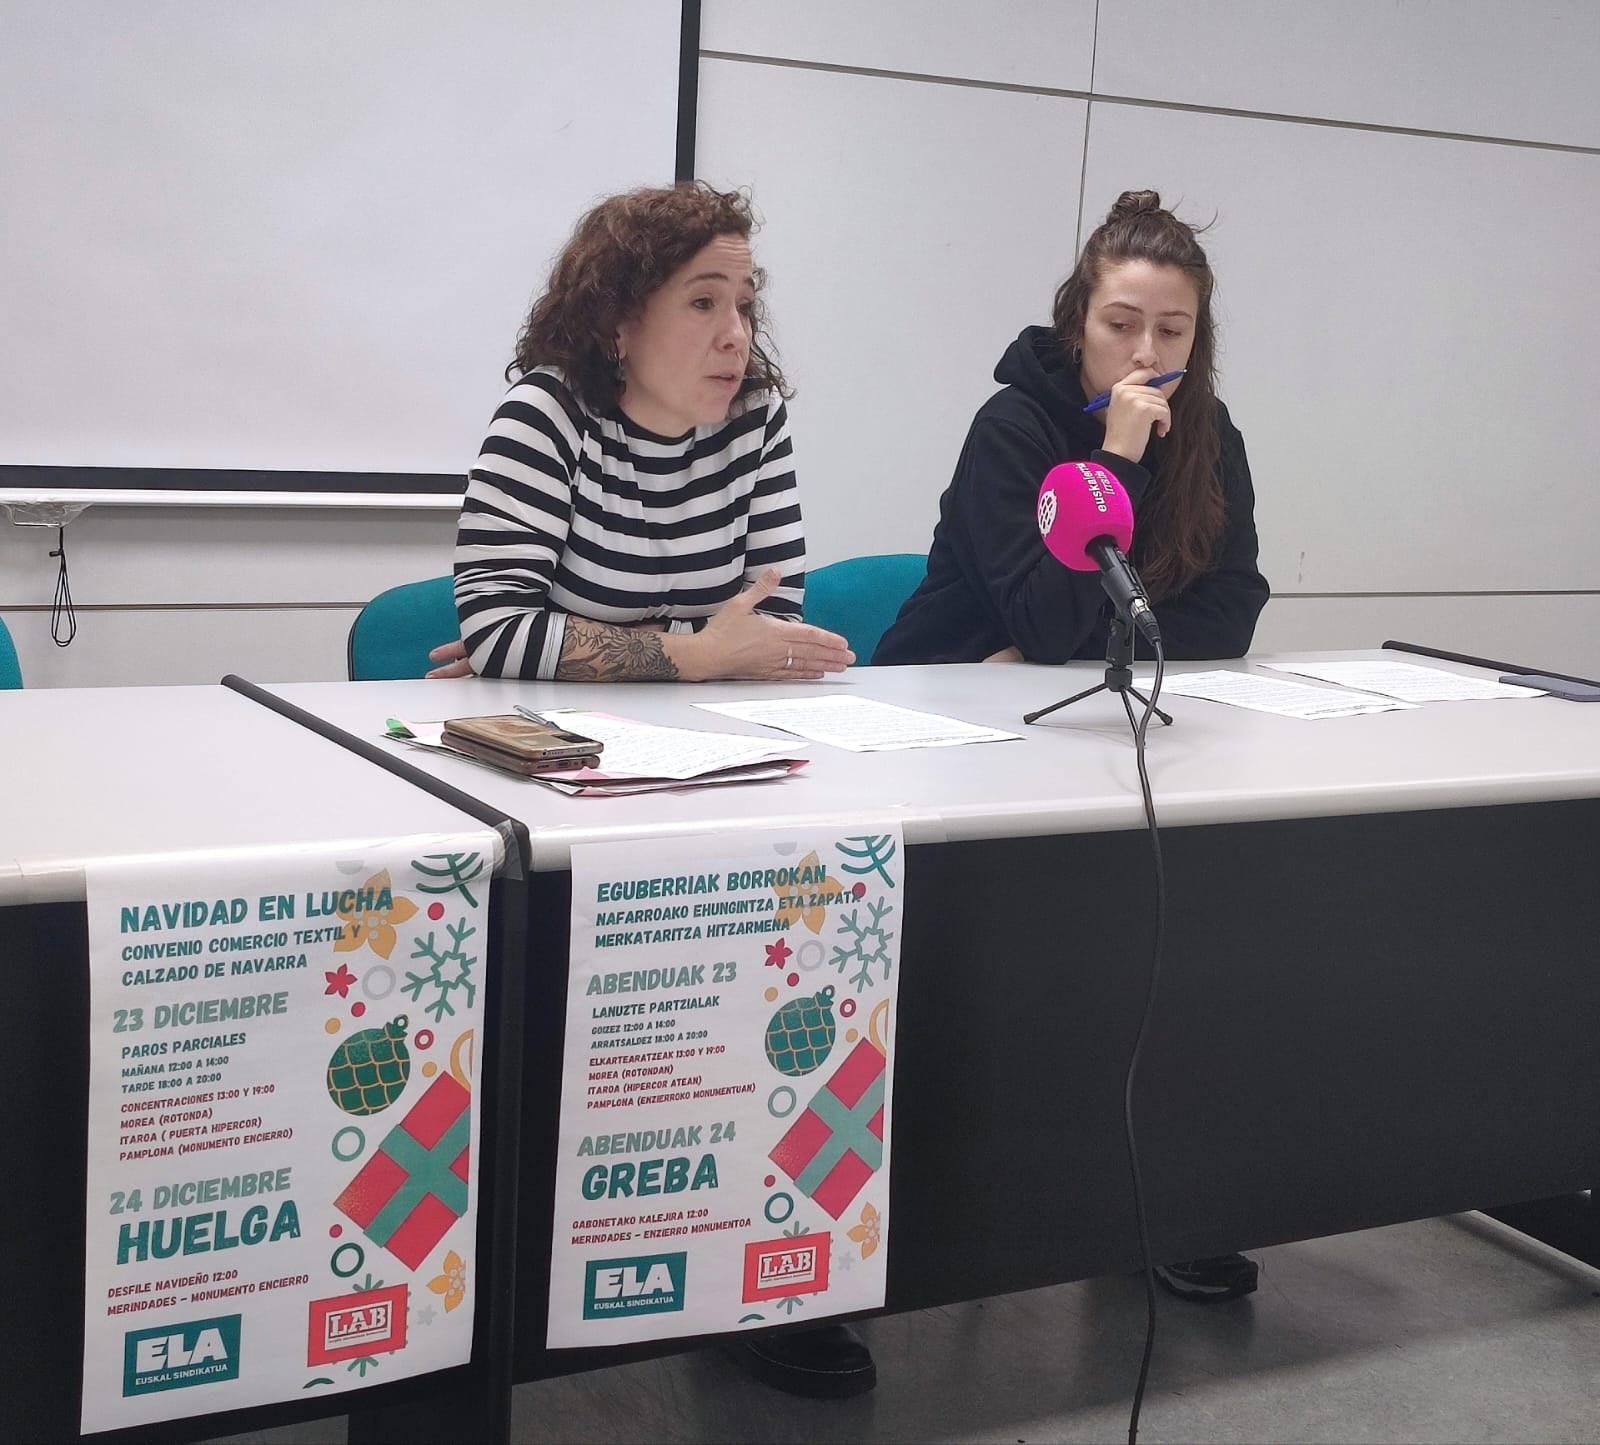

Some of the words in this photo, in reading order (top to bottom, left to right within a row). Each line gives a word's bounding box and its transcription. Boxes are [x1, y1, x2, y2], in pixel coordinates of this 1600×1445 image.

[597, 873, 720, 903] EGUBERRIAK
[727, 865, 826, 891] BORROKAN
[121, 898, 248, 933] NAVIDAD
[259, 895, 295, 921] EN
[306, 887, 393, 918] LUCHA
[596, 905, 688, 926] NAFARROAKO
[693, 898, 774, 918] EHUNGINTZA
[779, 896, 804, 909] ETA
[809, 891, 861, 907] ZAPATA
[122, 940, 202, 961] CONVENIO
[209, 932, 288, 953] COMERCIO
[293, 926, 345, 945] TEXTIL
[351, 924, 361, 939] Y
[595, 926, 701, 948] MERKATARITZA
[707, 918, 790, 938] HITZARMENA
[122, 965, 199, 986] CALZADO
[204, 962, 226, 978] DE
[231, 954, 307, 976] NAVARRA
[586, 964, 705, 996] ABENDUAK
[712, 961, 737, 983] 23
[113, 1008, 143, 1033] 23
[154, 991, 289, 1029] DICIEMBRE
[592, 1003, 645, 1019] LANUZTE
[650, 995, 720, 1014] PARTZIALAK
[591, 1036, 652, 1049] ARRATSALDEZ
[655, 1033, 675, 1043] 18:00
[677, 1032, 684, 1040] A
[686, 1030, 708, 1040] 20:00
[592, 1024, 621, 1035] GOIZEZ
[623, 1022, 644, 1032] 12:00
[646, 1021, 653, 1030] A
[122, 1042, 168, 1059] PAROS
[172, 1032, 247, 1053] PARCIALES
[589, 1051, 674, 1067] ELKARTEARATZEAK
[675, 1048, 695, 1058] 13:00
[698, 1047, 703, 1056] Y
[706, 1045, 726, 1055] 19:00
[121, 1063, 165, 1078] MAÑANA
[168, 1060, 193, 1072] 12:00
[196, 1059, 203, 1068] A
[206, 1055, 229, 1067] 14:00
[588, 1071, 618, 1081] MOREA
[621, 1064, 674, 1080] (ROTONDAN)
[122, 1081, 155, 1094] TARDE
[158, 1077, 182, 1089] 18:00
[186, 1076, 193, 1086] A
[196, 1072, 222, 1084] 20:00
[587, 1085, 620, 1095] ITAROA
[623, 1080, 668, 1094] (HIPERCOR
[670, 1075, 702, 1087] ATEAN)
[587, 1097, 634, 1109] PAMPLONA
[637, 1092, 691, 1107] (ENZIERROKO
[693, 1083, 756, 1099] MONUMENTUAN)
[121, 1092, 214, 1113] CONCENTRACIONES
[217, 1089, 240, 1101] 13:00
[243, 1087, 250, 1097] Y
[252, 1084, 275, 1096] 19:00
[120, 1117, 155, 1129] MOREA
[159, 1107, 213, 1125] (ROTONDA)
[120, 1133, 157, 1145] ITAROA
[169, 1127, 208, 1139] PUERTA
[211, 1116, 262, 1133] HIPERCOR)
[119, 1146, 175, 1161] PAMPLONA
[178, 1136, 241, 1156] (MONUMENTO
[243, 1128, 293, 1144] ENCIERRO)
[576, 1125, 703, 1157] ABENDUAK
[710, 1121, 736, 1144] 24
[109, 1189, 143, 1215] 24
[153, 1167, 292, 1210] DICIEMBRE
[581, 1153, 719, 1200] GREBA
[117, 1200, 301, 1265] HUELGA
[571, 1232, 632, 1245] MERINDADES
[643, 1226, 689, 1239] ENZIERRO
[691, 1218, 751, 1234] MONUMENTOA
[572, 1217, 636, 1230] GABONETAKO
[638, 1212, 684, 1224] KALEJIRA
[686, 1209, 709, 1219] 12:00
[763, 1252, 811, 1277] LAB
[107, 1282, 152, 1298] DESFILE
[155, 1272, 209, 1291] NAVIDEÑO
[212, 1269, 238, 1282] 12:00
[107, 1297, 176, 1316] MERINDADES
[191, 1283, 256, 1303] MONUMENTO
[258, 1275, 309, 1291] ENCIERRO
[594, 1263, 675, 1299] ELA
[594, 1302, 625, 1310] EUSKAL
[627, 1296, 674, 1307] SINDIKATUA
[330, 1307, 386, 1337] LAB
[136, 1328, 228, 1373] ELA
[135, 1373, 172, 1386] EUSKAL
[173, 1364, 228, 1379] SINDIKATUA
